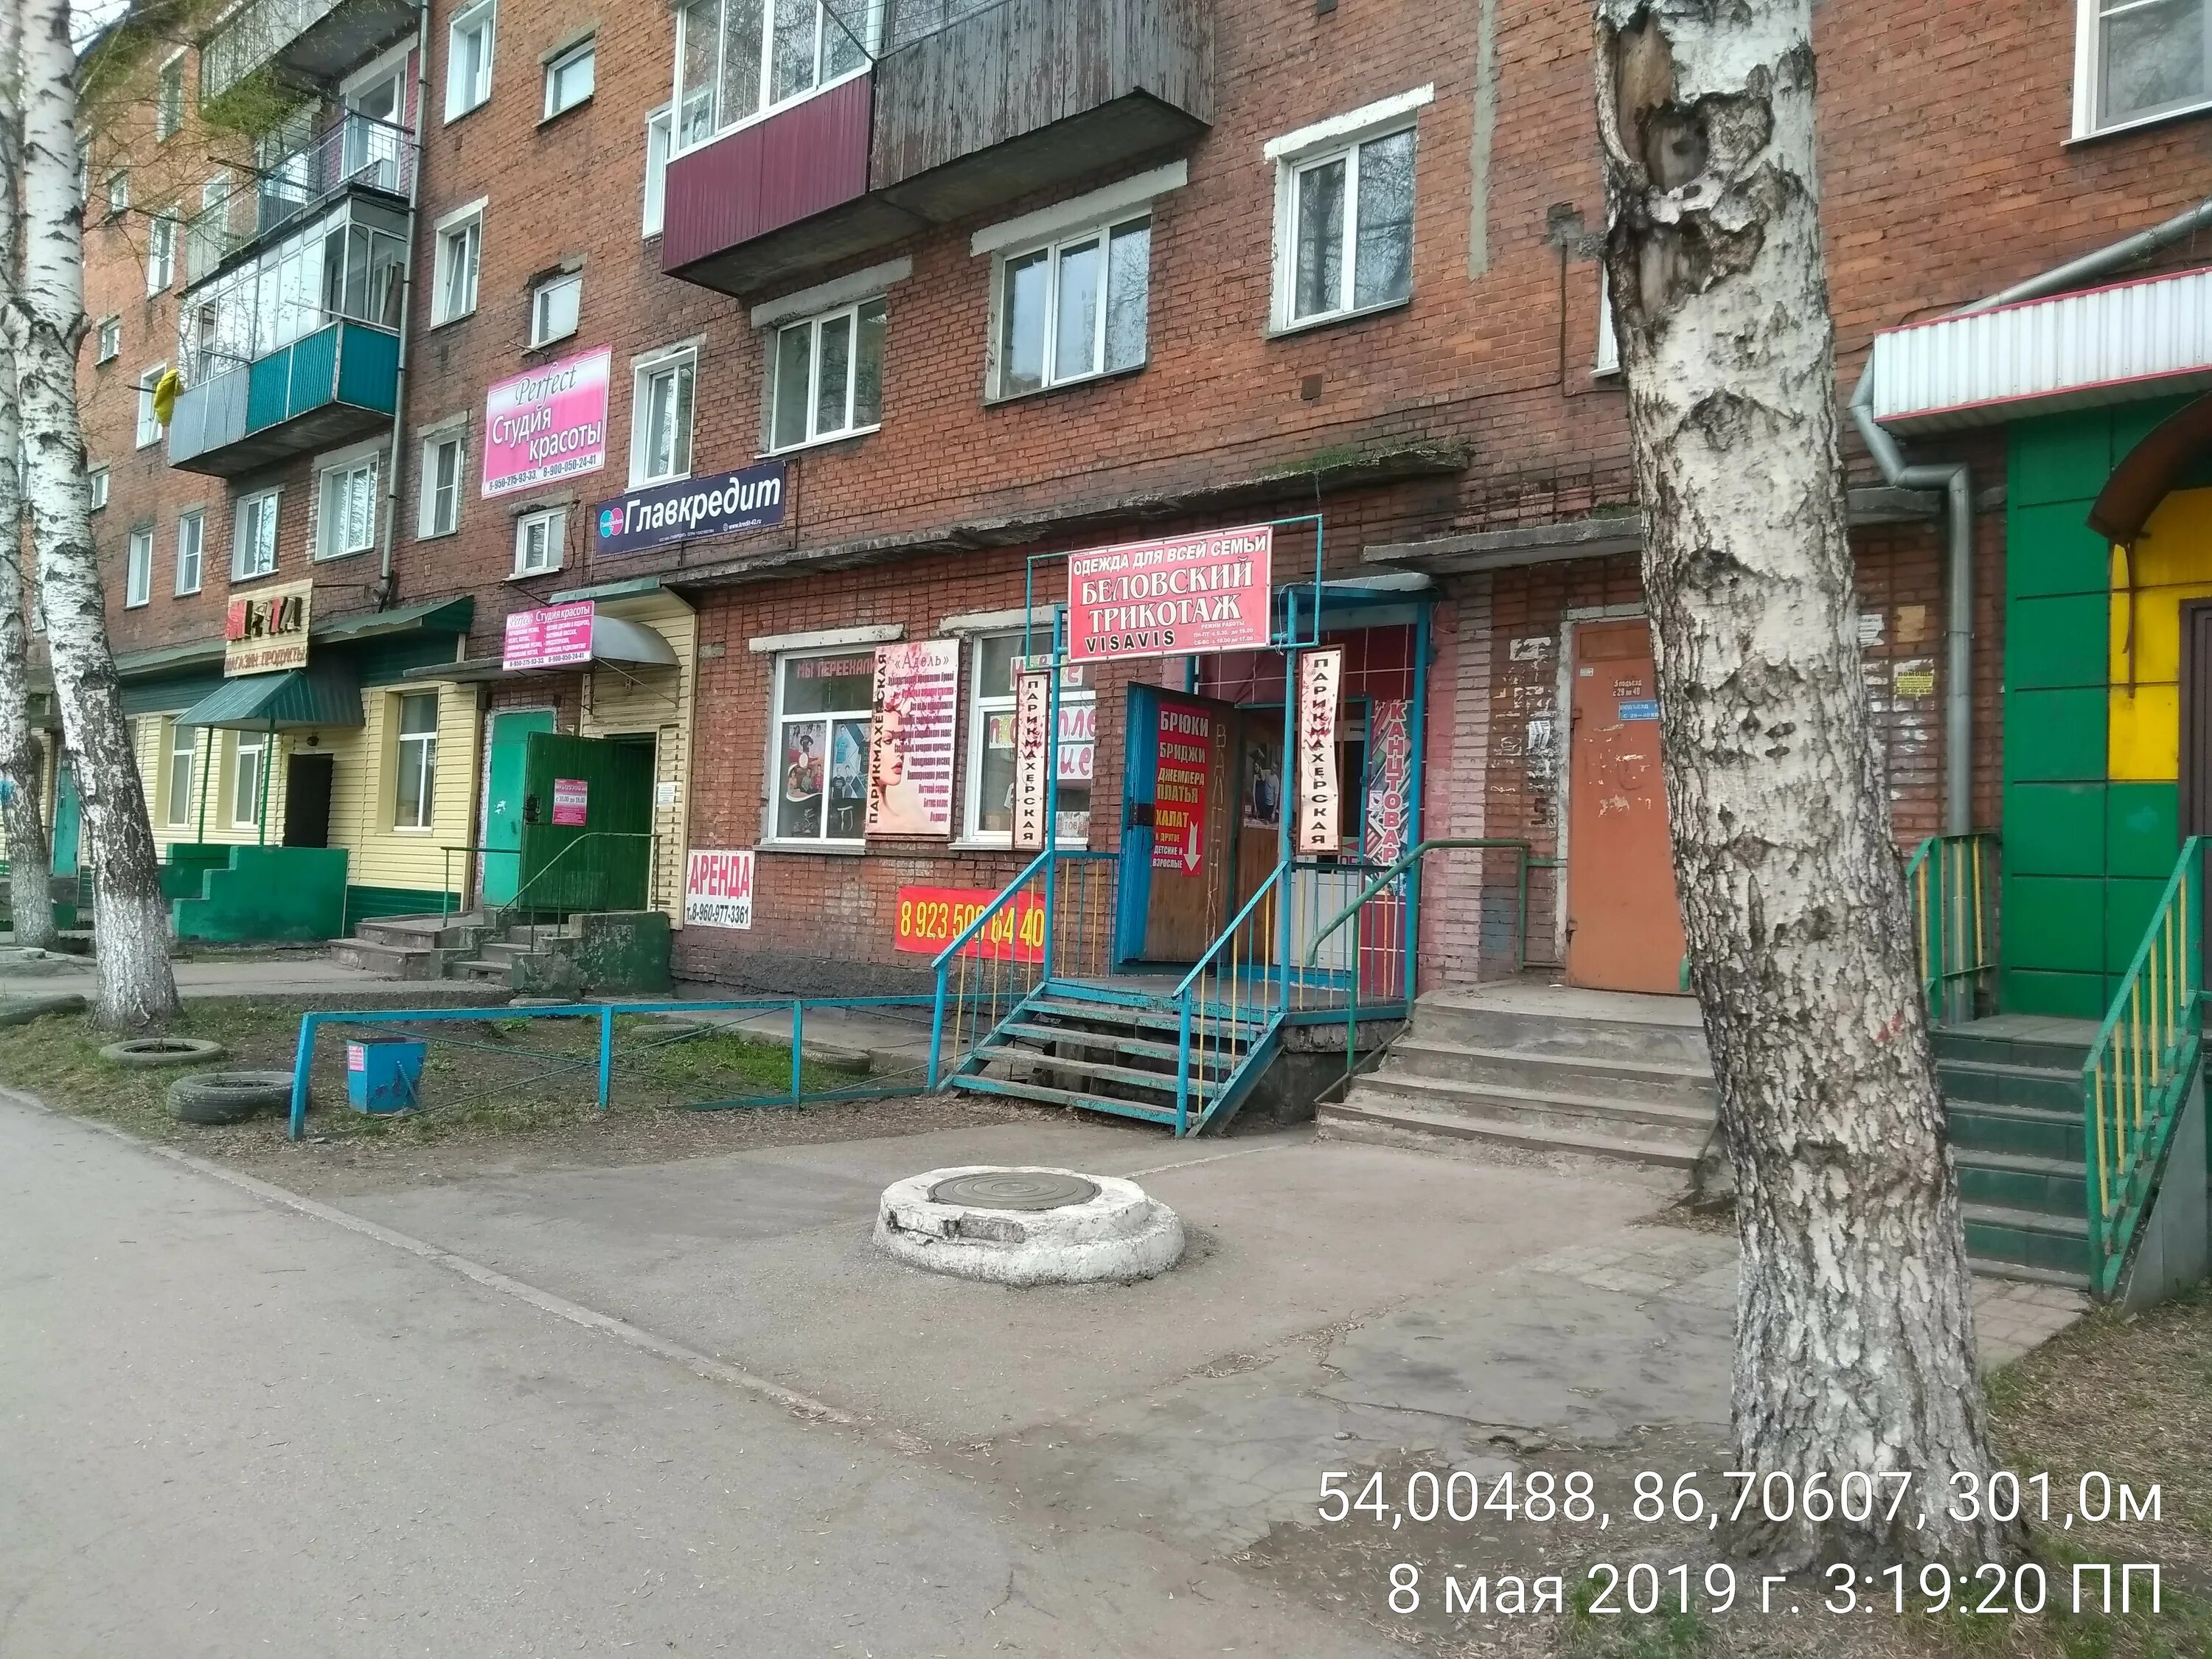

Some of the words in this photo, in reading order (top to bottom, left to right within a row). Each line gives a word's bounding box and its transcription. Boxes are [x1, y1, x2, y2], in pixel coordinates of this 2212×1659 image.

[515, 362, 577, 409] Perfect
[493, 408, 552, 448] Студия
[529, 420, 602, 467] красоты
[625, 477, 781, 535] Главкредит
[1074, 555, 1129, 577] ОДЕЖДА
[1132, 549, 1164, 570] ДЛЯ
[1166, 539, 1207, 563] ВСЕЙ
[1211, 535, 1267, 558] СЕМЬИ
[1082, 556, 1254, 606] БЕЛОВСКИЙ
[1089, 594, 1242, 633] ТРИКОТАЖ
[262, 646, 306, 667] ПРОДУКТЫ
[1085, 630, 1175, 654] VISAVIS
[869, 654, 887, 824] ПАРИКМАХЕРСКАЯ
[1160, 710, 1208, 737] БРЮКИ
[1023, 681, 1039, 840] ПАРИКМАХЕРСКАЯ
[1160, 742, 1206, 764] БРИДЖИ
[1311, 659, 1329, 844] ПАРИКМАХЕРСКАЯ
[1156, 784, 1198, 804] ПЛАТЬЯ
[1158, 768, 1205, 786] ДЖЕМПЕРА
[1156, 809, 1189, 828] ХАЛАТ
[1160, 832, 1180, 844] ДРУГОЕ
[1152, 858, 1183, 869] ВЗРОСЛЫЕ
[1154, 845, 1178, 856] ДЕТСКИЕ
[688, 855, 750, 900] АРЕНДА
[900, 900, 912, 936] 8
[915, 902, 949, 939] 923
[1020, 908, 1045, 947] 40
